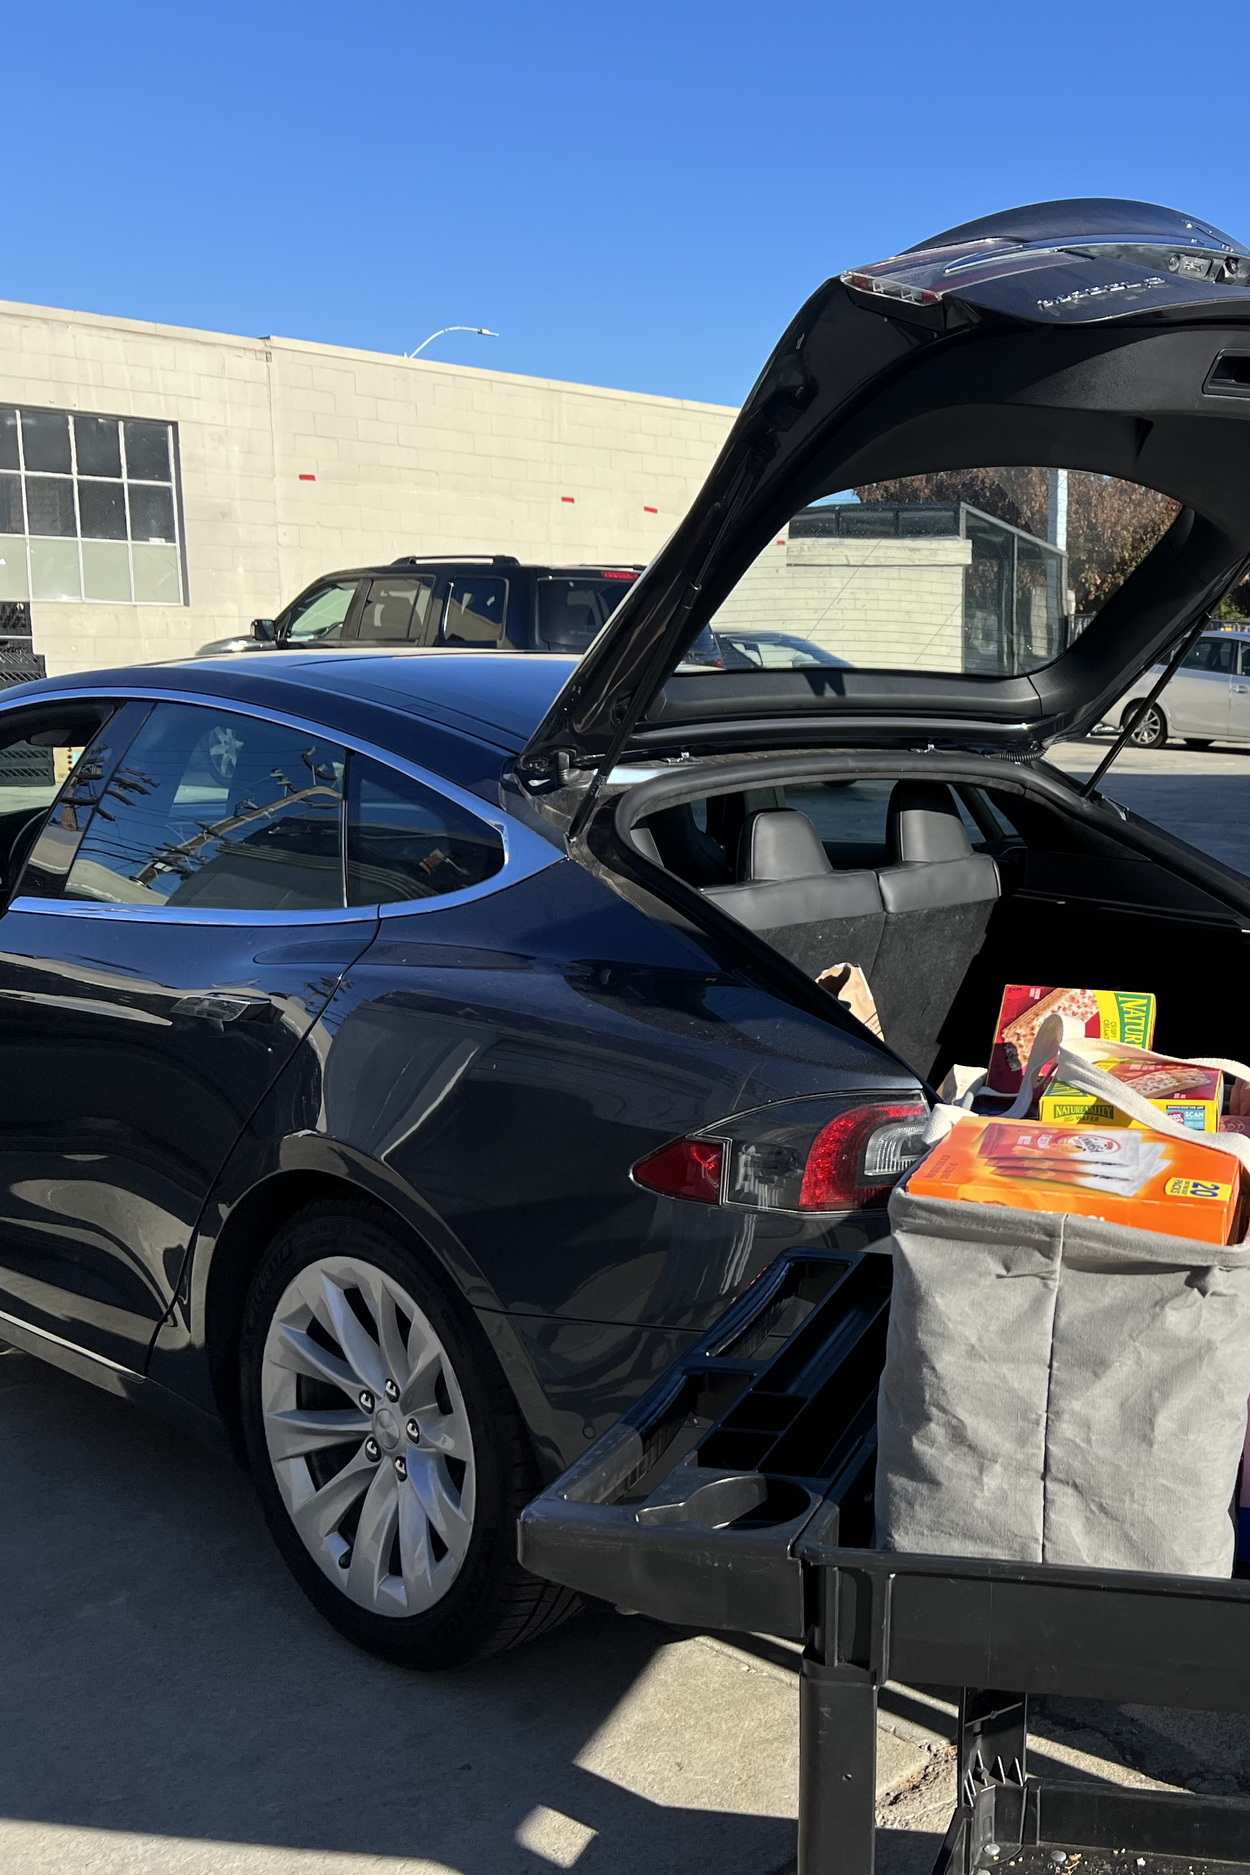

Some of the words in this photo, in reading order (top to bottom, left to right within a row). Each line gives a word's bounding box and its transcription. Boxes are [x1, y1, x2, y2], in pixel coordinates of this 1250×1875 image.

[1055, 1105, 1084, 1117] NATURE
[1085, 1105, 1113, 1118] VALLEY
[1190, 1182, 1220, 1198] 20
